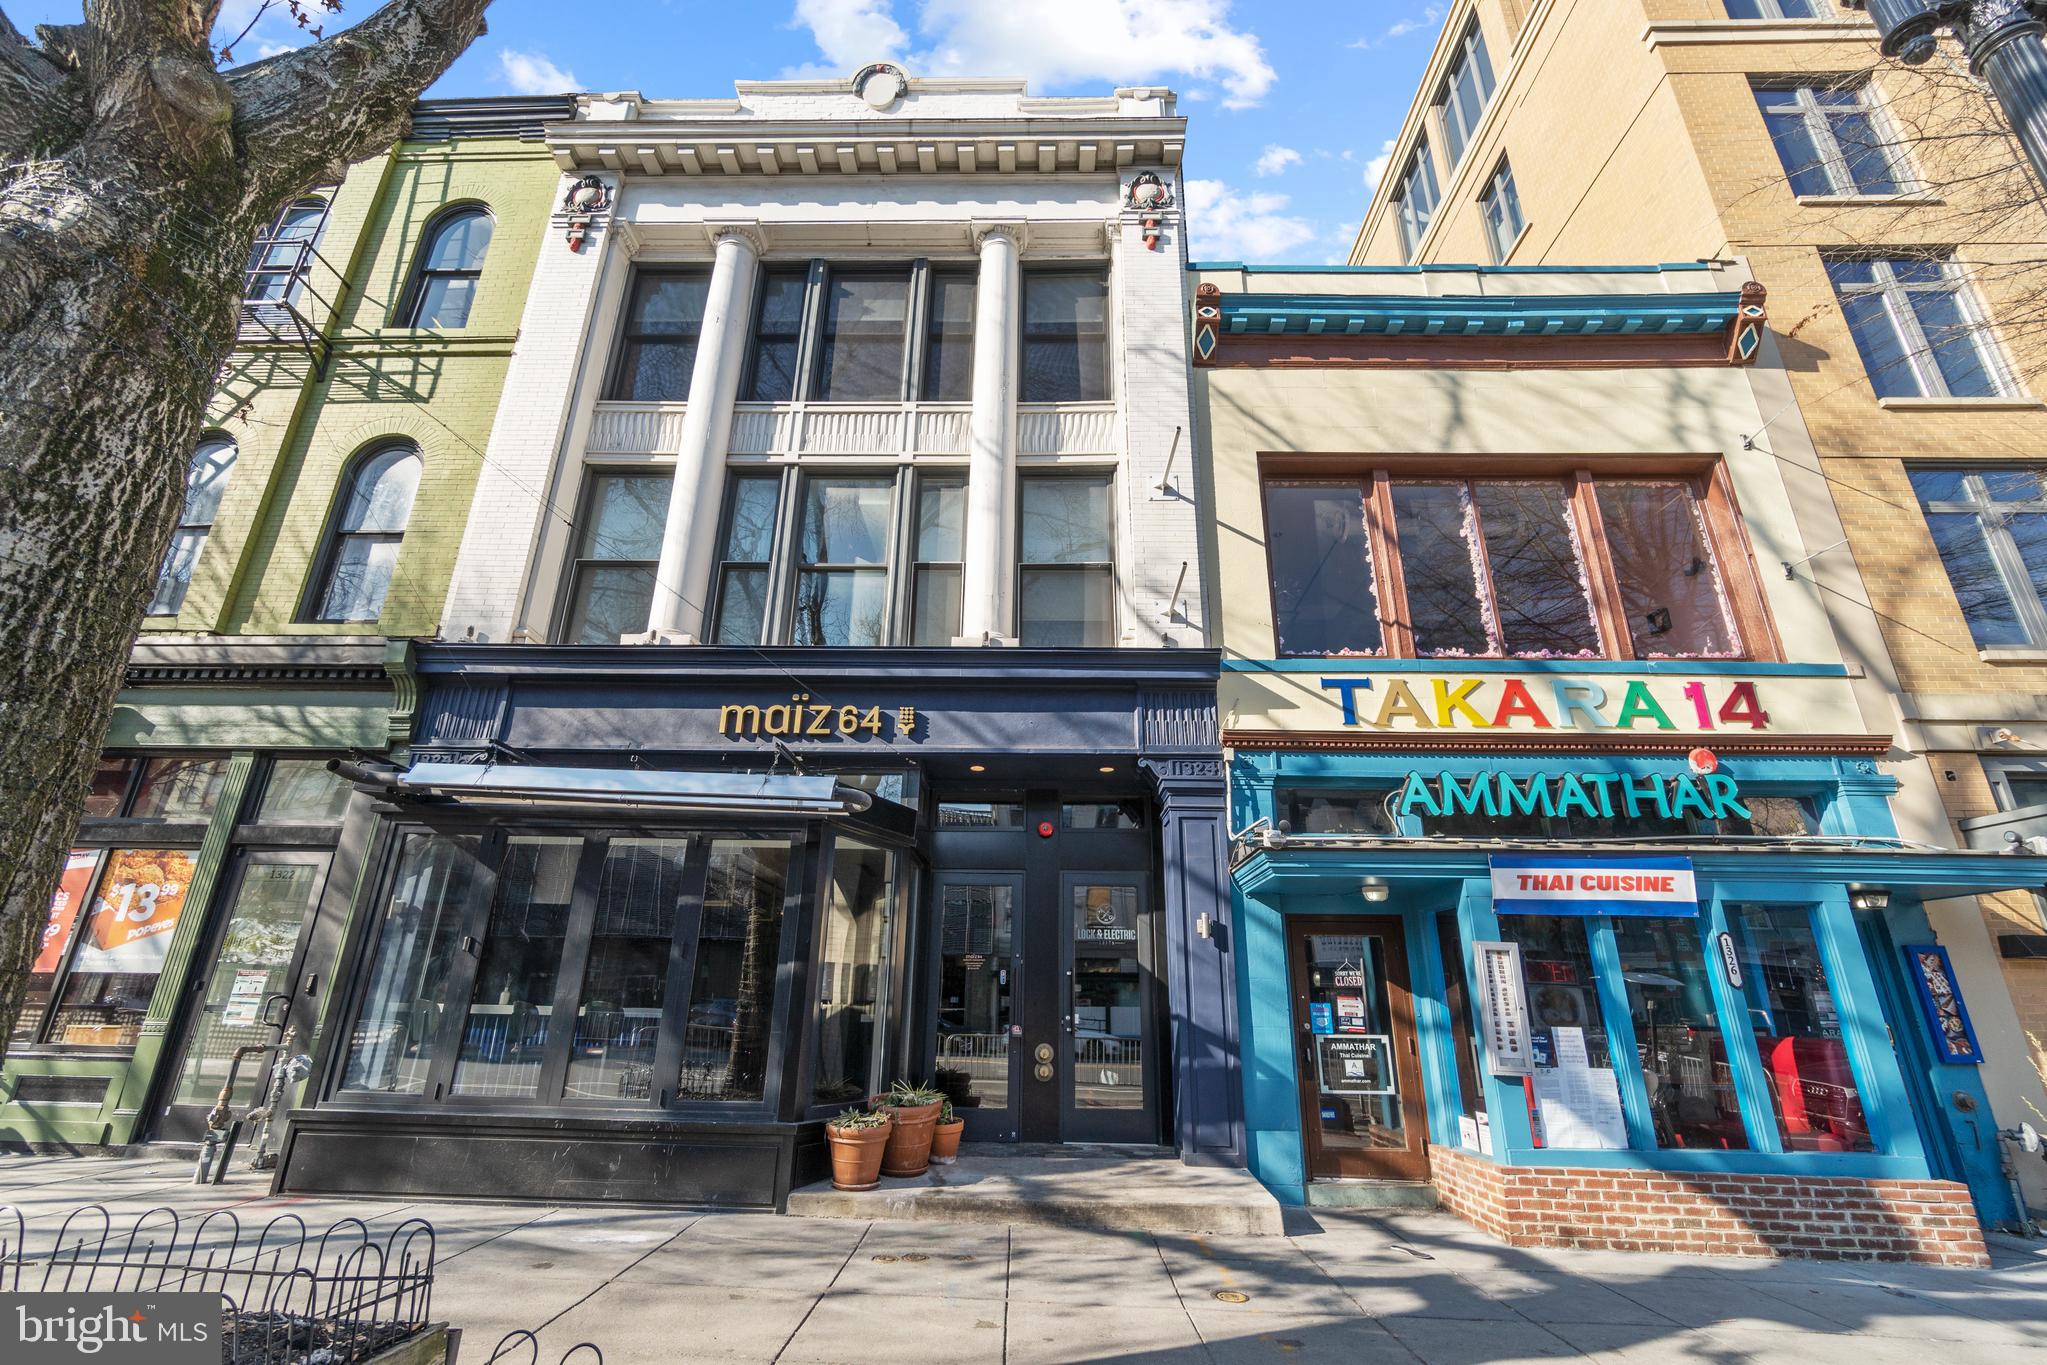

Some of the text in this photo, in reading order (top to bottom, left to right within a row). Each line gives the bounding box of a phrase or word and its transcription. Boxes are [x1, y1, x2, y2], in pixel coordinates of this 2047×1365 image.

[1320, 677, 1770, 731] TAKARA 14
[1173, 761, 1219, 776] 1324
[1399, 770, 1753, 820] AMMATHAR
[270, 870, 296, 880] 1322
[1517, 874, 1675, 893] THAI CUISINE
[1077, 929, 1136, 941] LOCK & ELECTRIC
[1723, 938, 1738, 976] 1326
[1335, 976, 1363, 987] CLOSED
[1331, 1042, 1377, 1051] AMMATHAR
